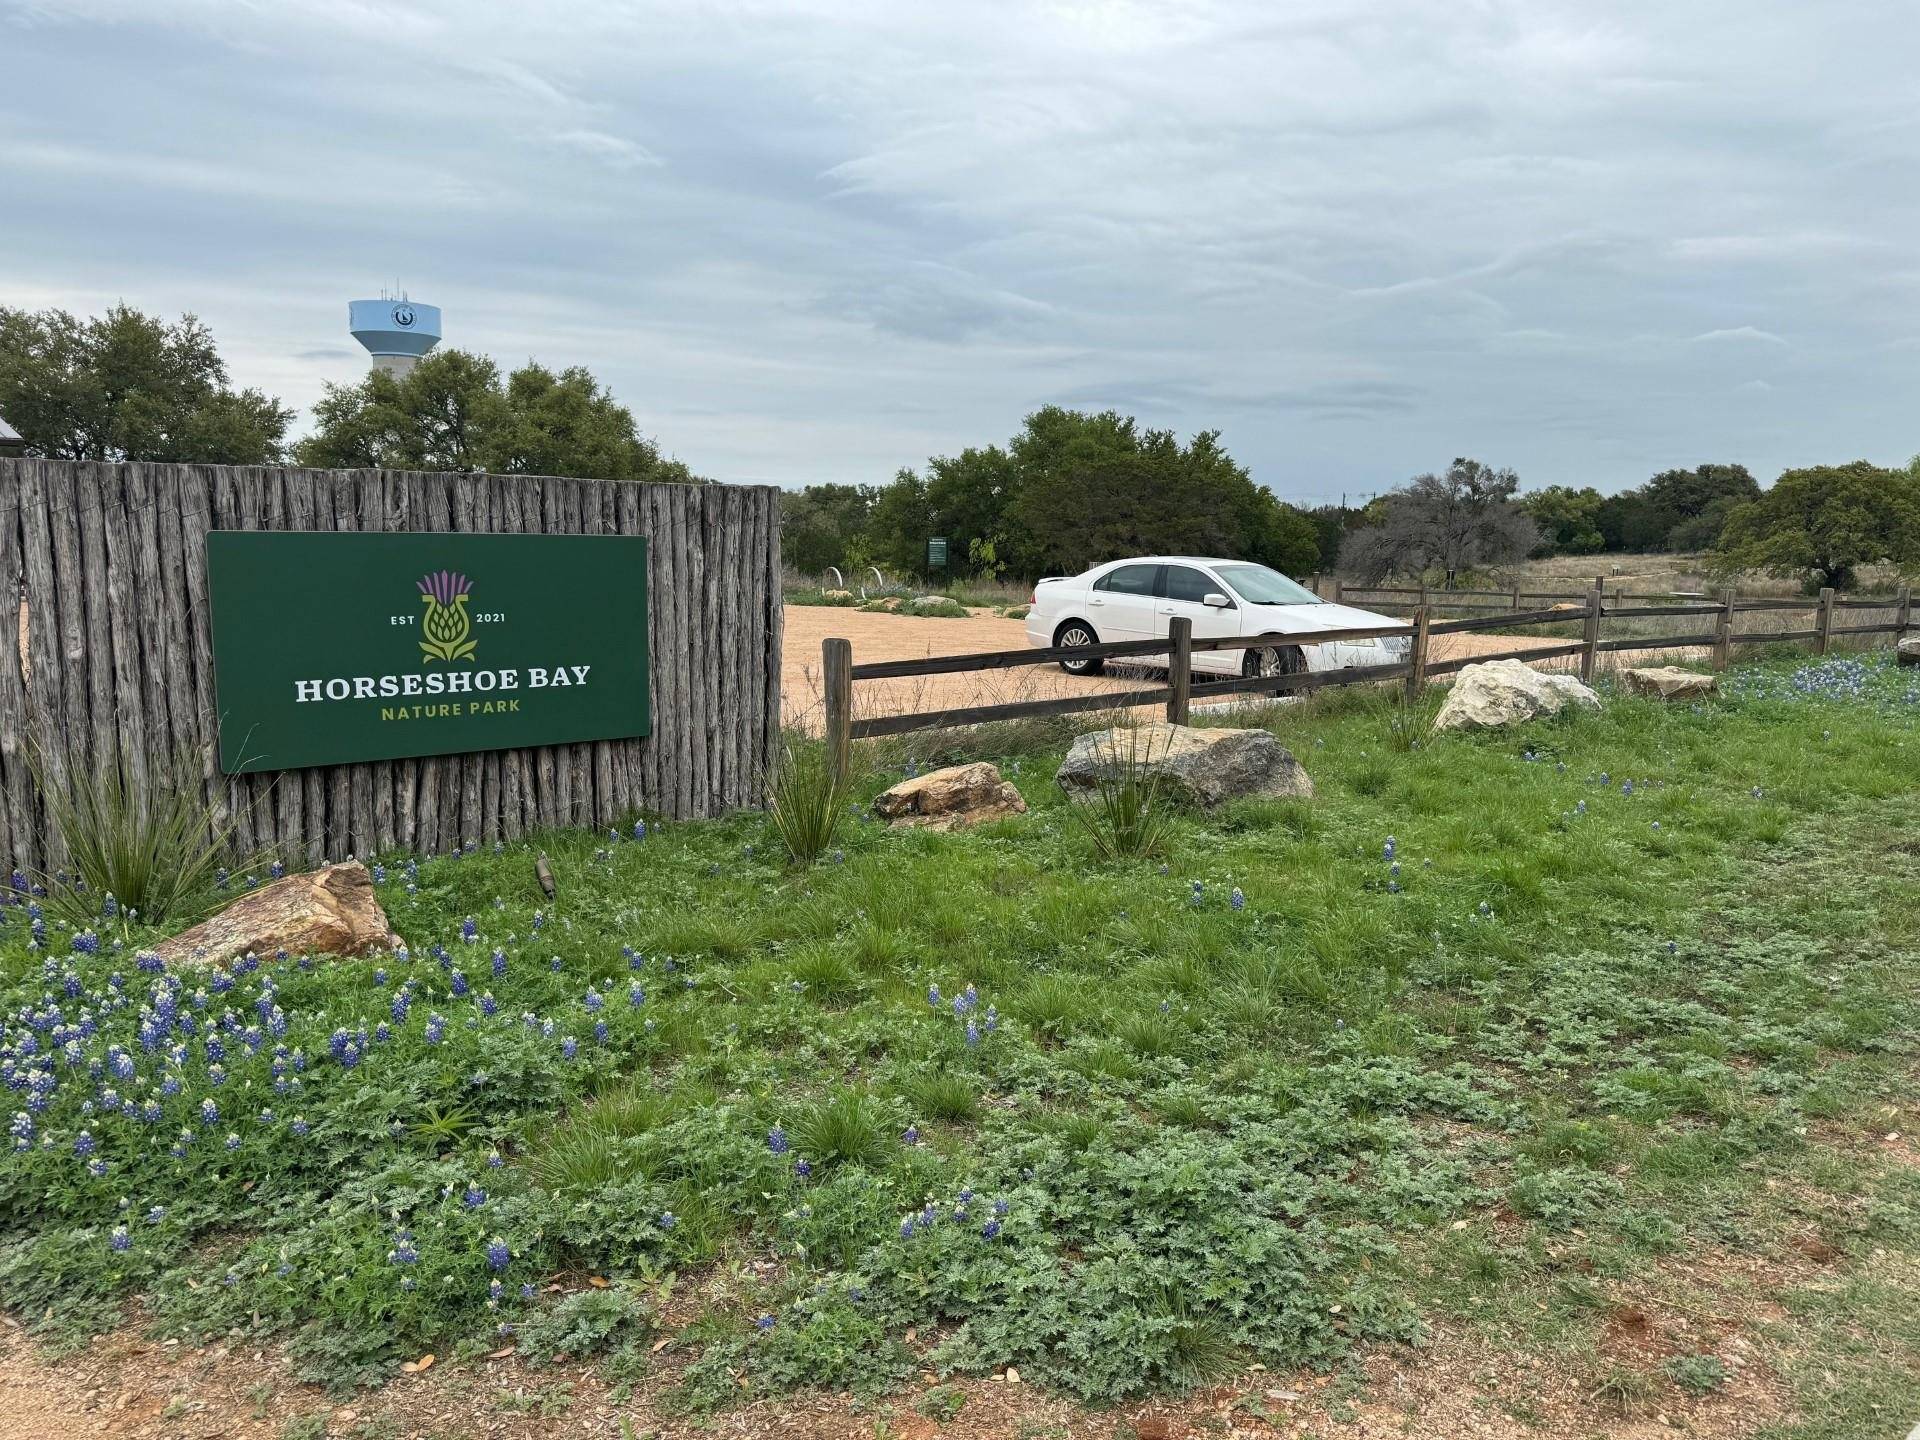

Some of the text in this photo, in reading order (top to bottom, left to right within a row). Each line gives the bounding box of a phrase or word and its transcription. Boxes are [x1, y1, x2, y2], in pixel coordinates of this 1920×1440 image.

[390, 613, 506, 626] EST 2021
[294, 665, 591, 703] HORSESHOE BAY
[381, 699, 521, 721] NATURE PARK
